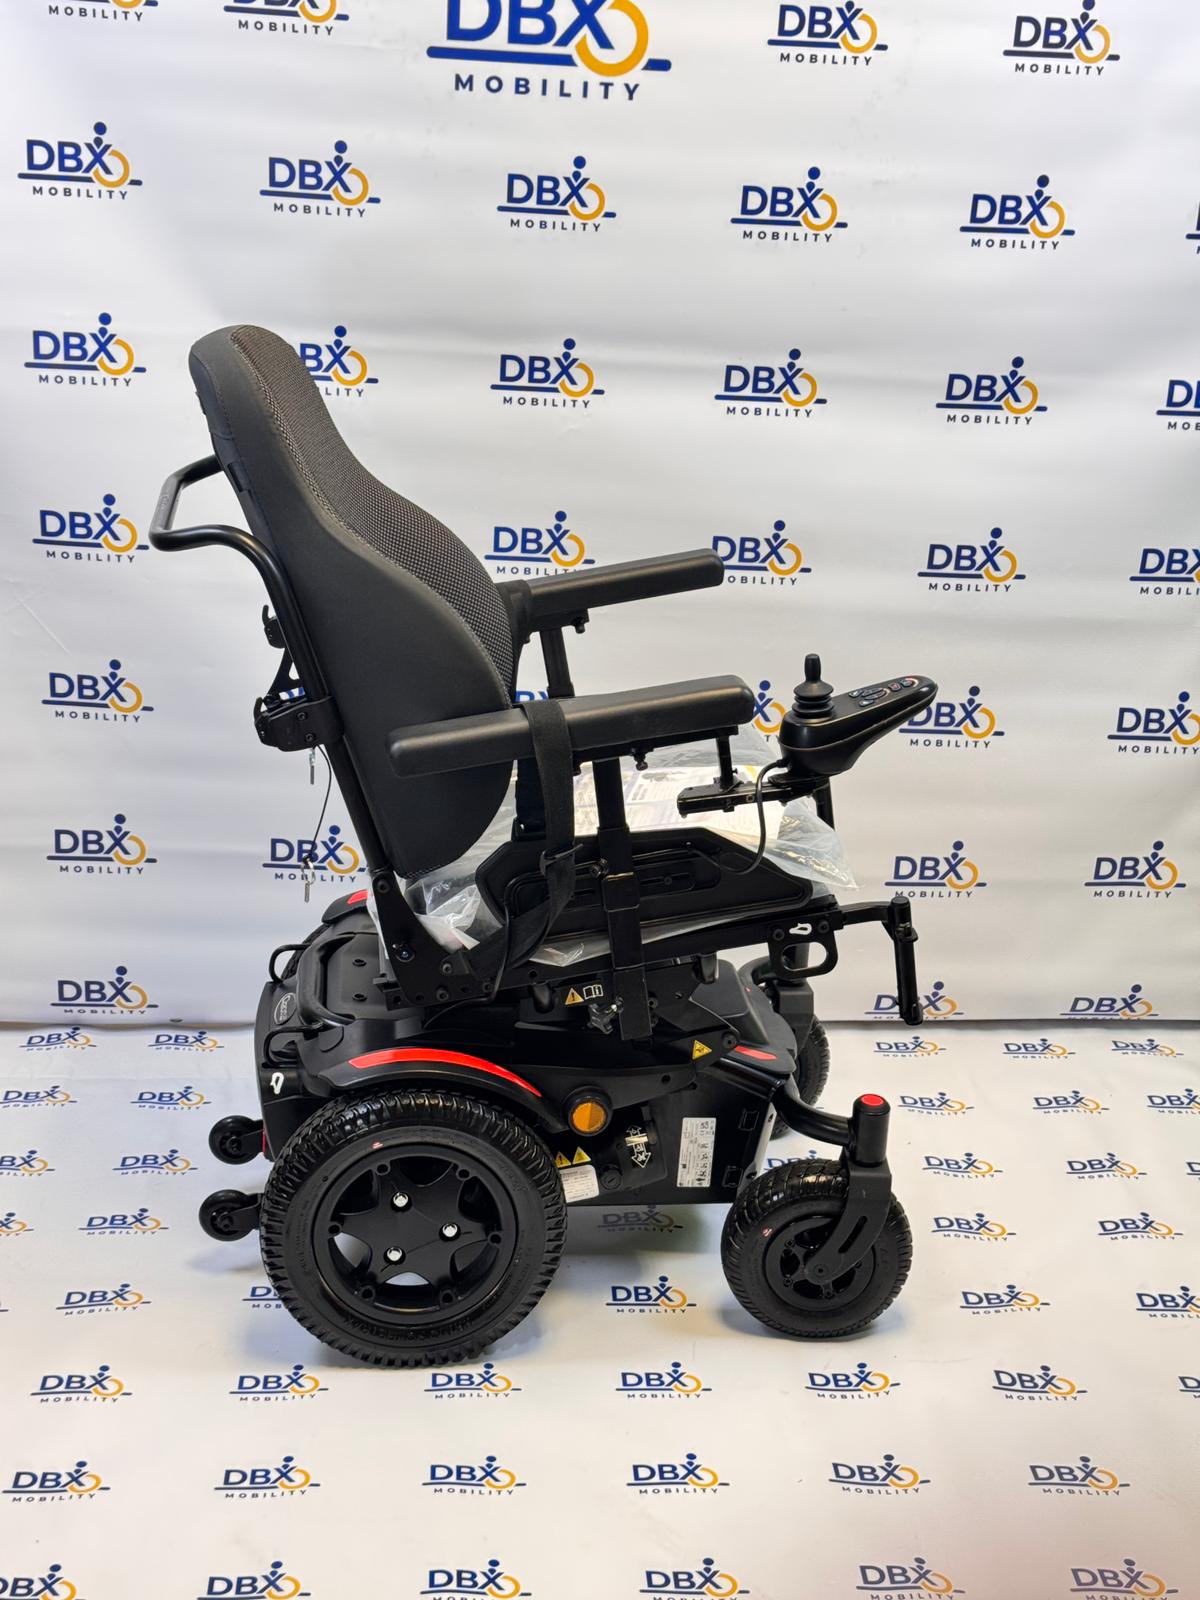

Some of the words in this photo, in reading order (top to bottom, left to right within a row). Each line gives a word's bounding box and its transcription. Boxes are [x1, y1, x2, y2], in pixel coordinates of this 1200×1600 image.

[49, 5, 143, 22] MOBILITY
[238, 20, 334, 36] MOBILITY
[446, 0, 614, 49] DBX
[778, 4, 861, 39] DBX
[1014, 15, 1097, 50] DBX
[780, 53, 872, 65] MOBILITY
[1015, 63, 1104, 75] MOBILITY
[455, 73, 639, 100] MOBILITY
[27, 139, 113, 174] DBX
[269, 157, 352, 193] DBX
[32, 186, 128, 200] MOBILITY
[507, 173, 590, 208] DBX
[742, 185, 823, 218] DBX
[273, 203, 365, 217] MOBILITY
[970, 194, 1051, 225] DBX
[510, 219, 600, 232] MOBILITY
[743, 230, 832, 242] MOBILITY
[971, 238, 1059, 249] MOBILITY
[33, 330, 117, 362] DBX
[500, 356, 580, 385] DBX
[39, 375, 132, 387] MOBILITY
[724, 365, 803, 394] DBX
[325, 387, 364, 397] LITY
[946, 374, 1025, 401] DBX
[503, 397, 590, 407] MOBILITY
[727, 406, 812, 417] MOBILITY
[947, 413, 1032, 425] MOBILITY
[39, 510, 121, 540] DBX
[493, 527, 570, 555] DBX
[46, 550, 135, 563] MOBILITY
[712, 536, 788, 564] DBX
[927, 544, 1003, 571] DBX
[497, 566, 576, 575] MOBILIT
[728, 576, 797, 585] OBILITY
[928, 582, 1011, 592] MOBILITY
[1140, 587, 1200, 595] MOBILI
[49, 673, 128, 701] DBX
[55, 710, 140, 723] MOBILITY
[1117, 707, 1190, 733] DBX
[910, 738, 990, 748] MOBILITY
[1118, 745, 1199, 754] MOBILITY
[54, 830, 130, 853] DBX
[271, 838, 344, 864] DBX
[60, 865, 143, 874] MOBILITY
[895, 856, 967, 880] DBX
[1095, 857, 1170, 880] DBX
[275, 873, 356, 882] MOBLITY
[895, 890, 973, 898] MOBILITY
[1094, 890, 1173, 898] MOBILITY
[58, 980, 133, 1002] DBX
[1070, 997, 1142, 1013] DBX
[27, 1032, 80, 1045] DBX
[155, 1034, 207, 1045] DBX
[876, 1040, 930, 1050] DBX
[1003, 1042, 1057, 1052] DBX
[3, 1091, 59, 1101] DBX
[138, 1091, 193, 1102] DBX
[900, 1096, 954, 1108] DBX
[1034, 1096, 1090, 1107] DBX
[1147, 1095, 1200, 1106] DBX
[120, 1155, 178, 1167] DBX
[925, 1156, 981, 1170] DBX
[1066, 1159, 1126, 1171] DBX
[87, 1214, 152, 1227] DBX
[602, 1212, 662, 1224] DBX
[934, 1217, 994, 1232] DBX
[1099, 1218, 1161, 1232] DBX
[65, 1290, 131, 1305] DBX
[611, 1286, 674, 1303] DBX
[962, 1291, 1026, 1305] DBX
[1136, 1293, 1200, 1308] DBX
[65, 1307, 138, 1316] MOBILITY
[40, 1375, 112, 1390] DBX
[238, 1374, 306, 1390] DBX
[431, 1373, 498, 1387] DBX
[621, 1372, 688, 1387] DBX
[808, 1372, 873, 1388] DBX
[995, 1369, 1062, 1390] DBX
[40, 1395, 119, 1403] MOBILITY
[239, 1394, 316, 1402] MOBILITY
[817, 1391, 891, 1399] MOBILITY
[224, 1466, 297, 1485] DBX
[430, 1465, 501, 1482] DBX
[633, 1464, 703, 1481] DBX
[831, 1462, 903, 1482] DBX
[1029, 1465, 1104, 1483] DBX
[13, 1471, 89, 1488] DBX
[225, 1490, 306, 1499] MOBILITY
[841, 1486, 920, 1495] MOBILITY
[12, 1493, 96, 1503] MOBILITY
[428, 1569, 505, 1590] DBX
[645, 1570, 723, 1589] DBX
[859, 1565, 938, 1587] DBX
[1070, 1568, 1151, 1589] DBX
[206, 1574, 286, 1595] DBX
